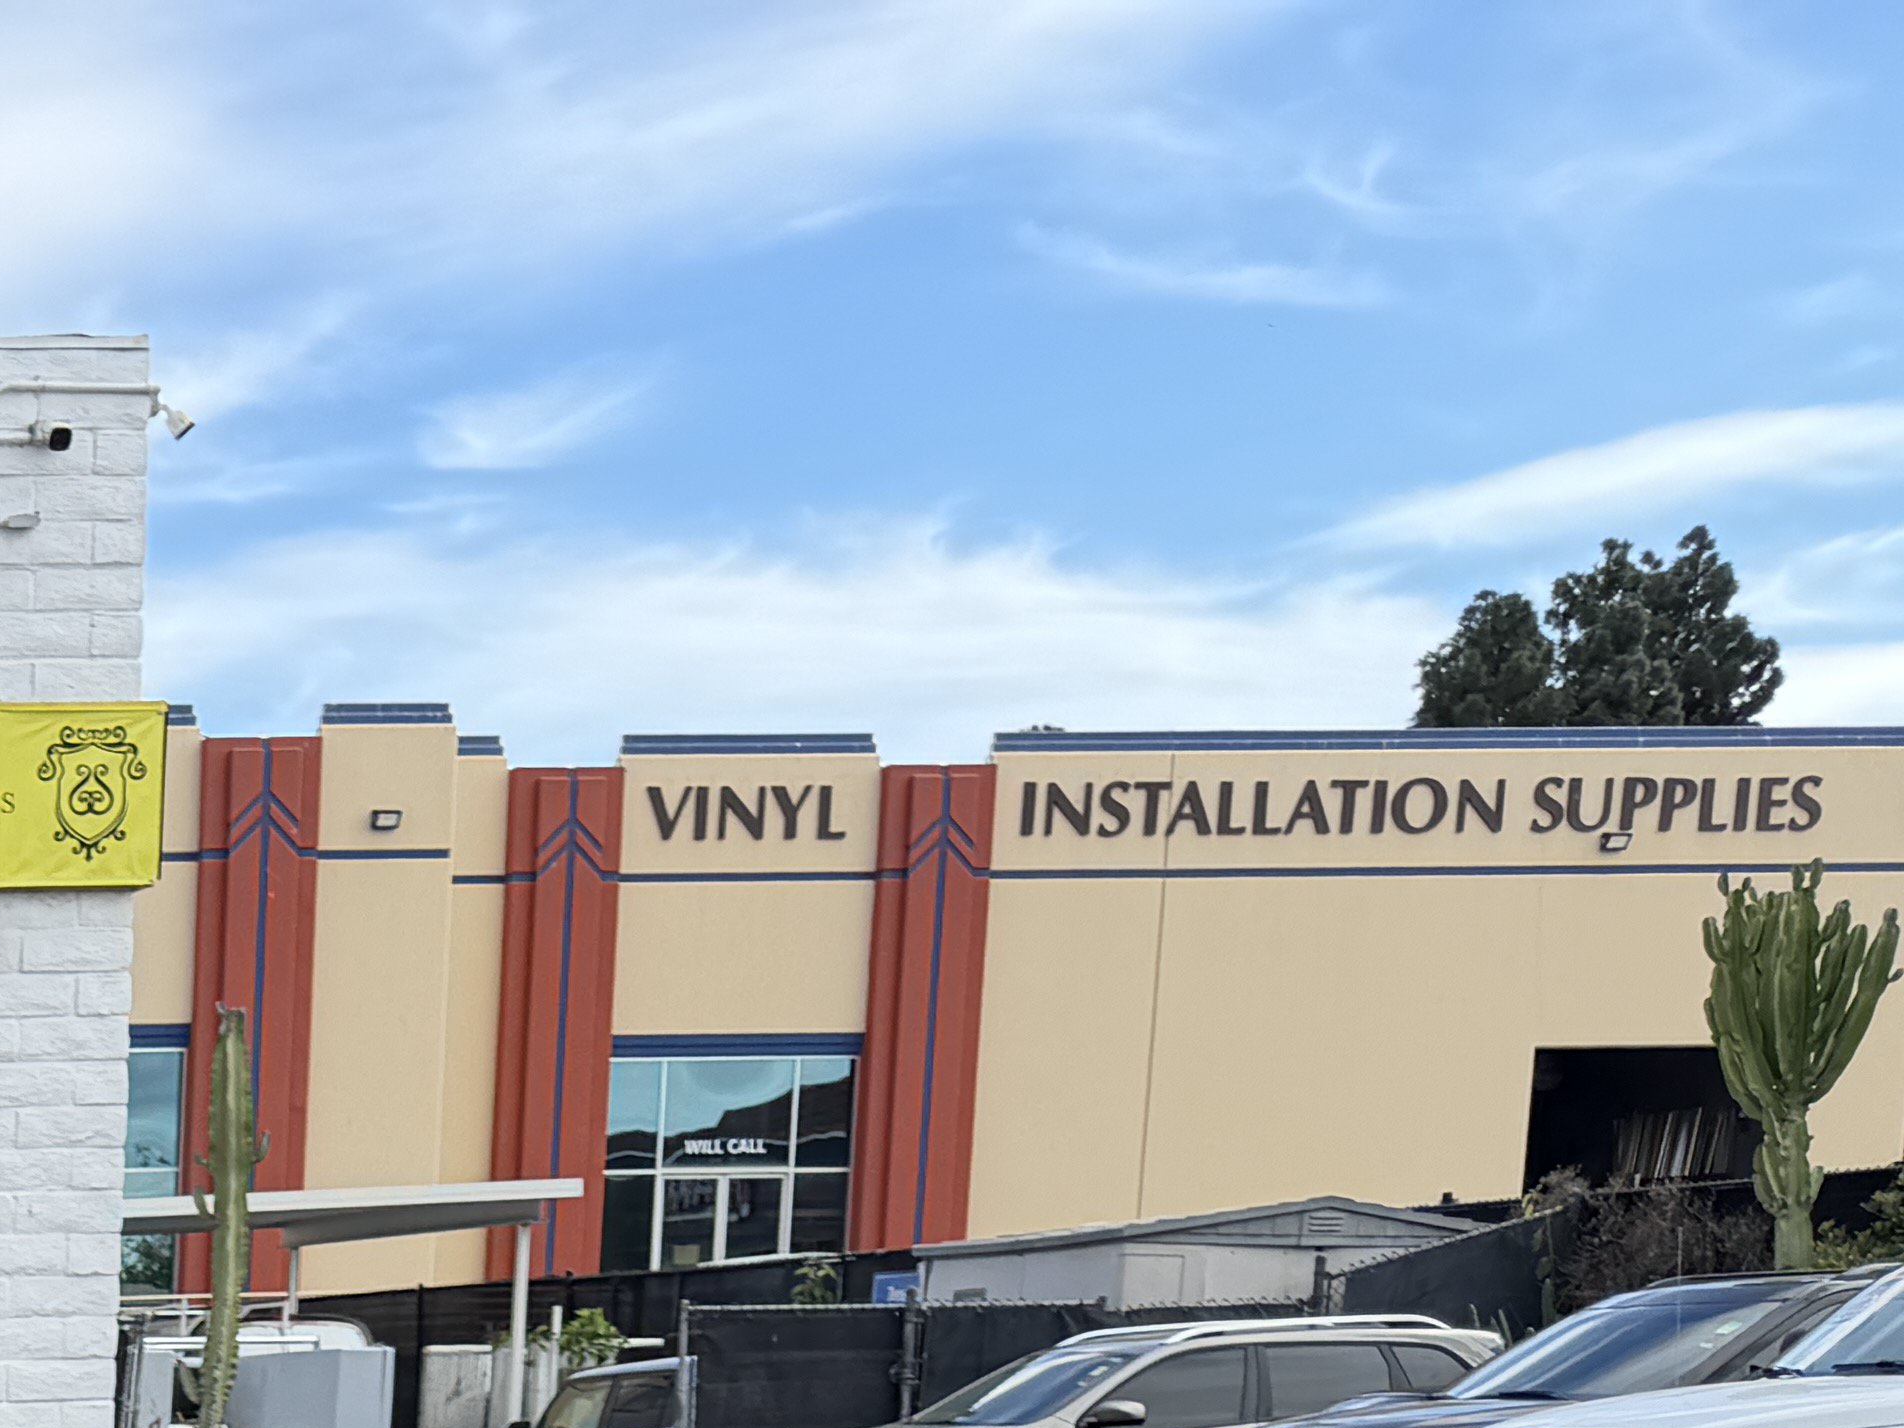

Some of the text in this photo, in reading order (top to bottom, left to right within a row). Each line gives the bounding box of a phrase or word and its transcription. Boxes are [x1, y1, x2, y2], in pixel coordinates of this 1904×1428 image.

[646, 784, 847, 841] VINYL
[1019, 775, 1824, 837] INSTALLATION SUPPLIES
[726, 1138, 768, 1154] CALL
